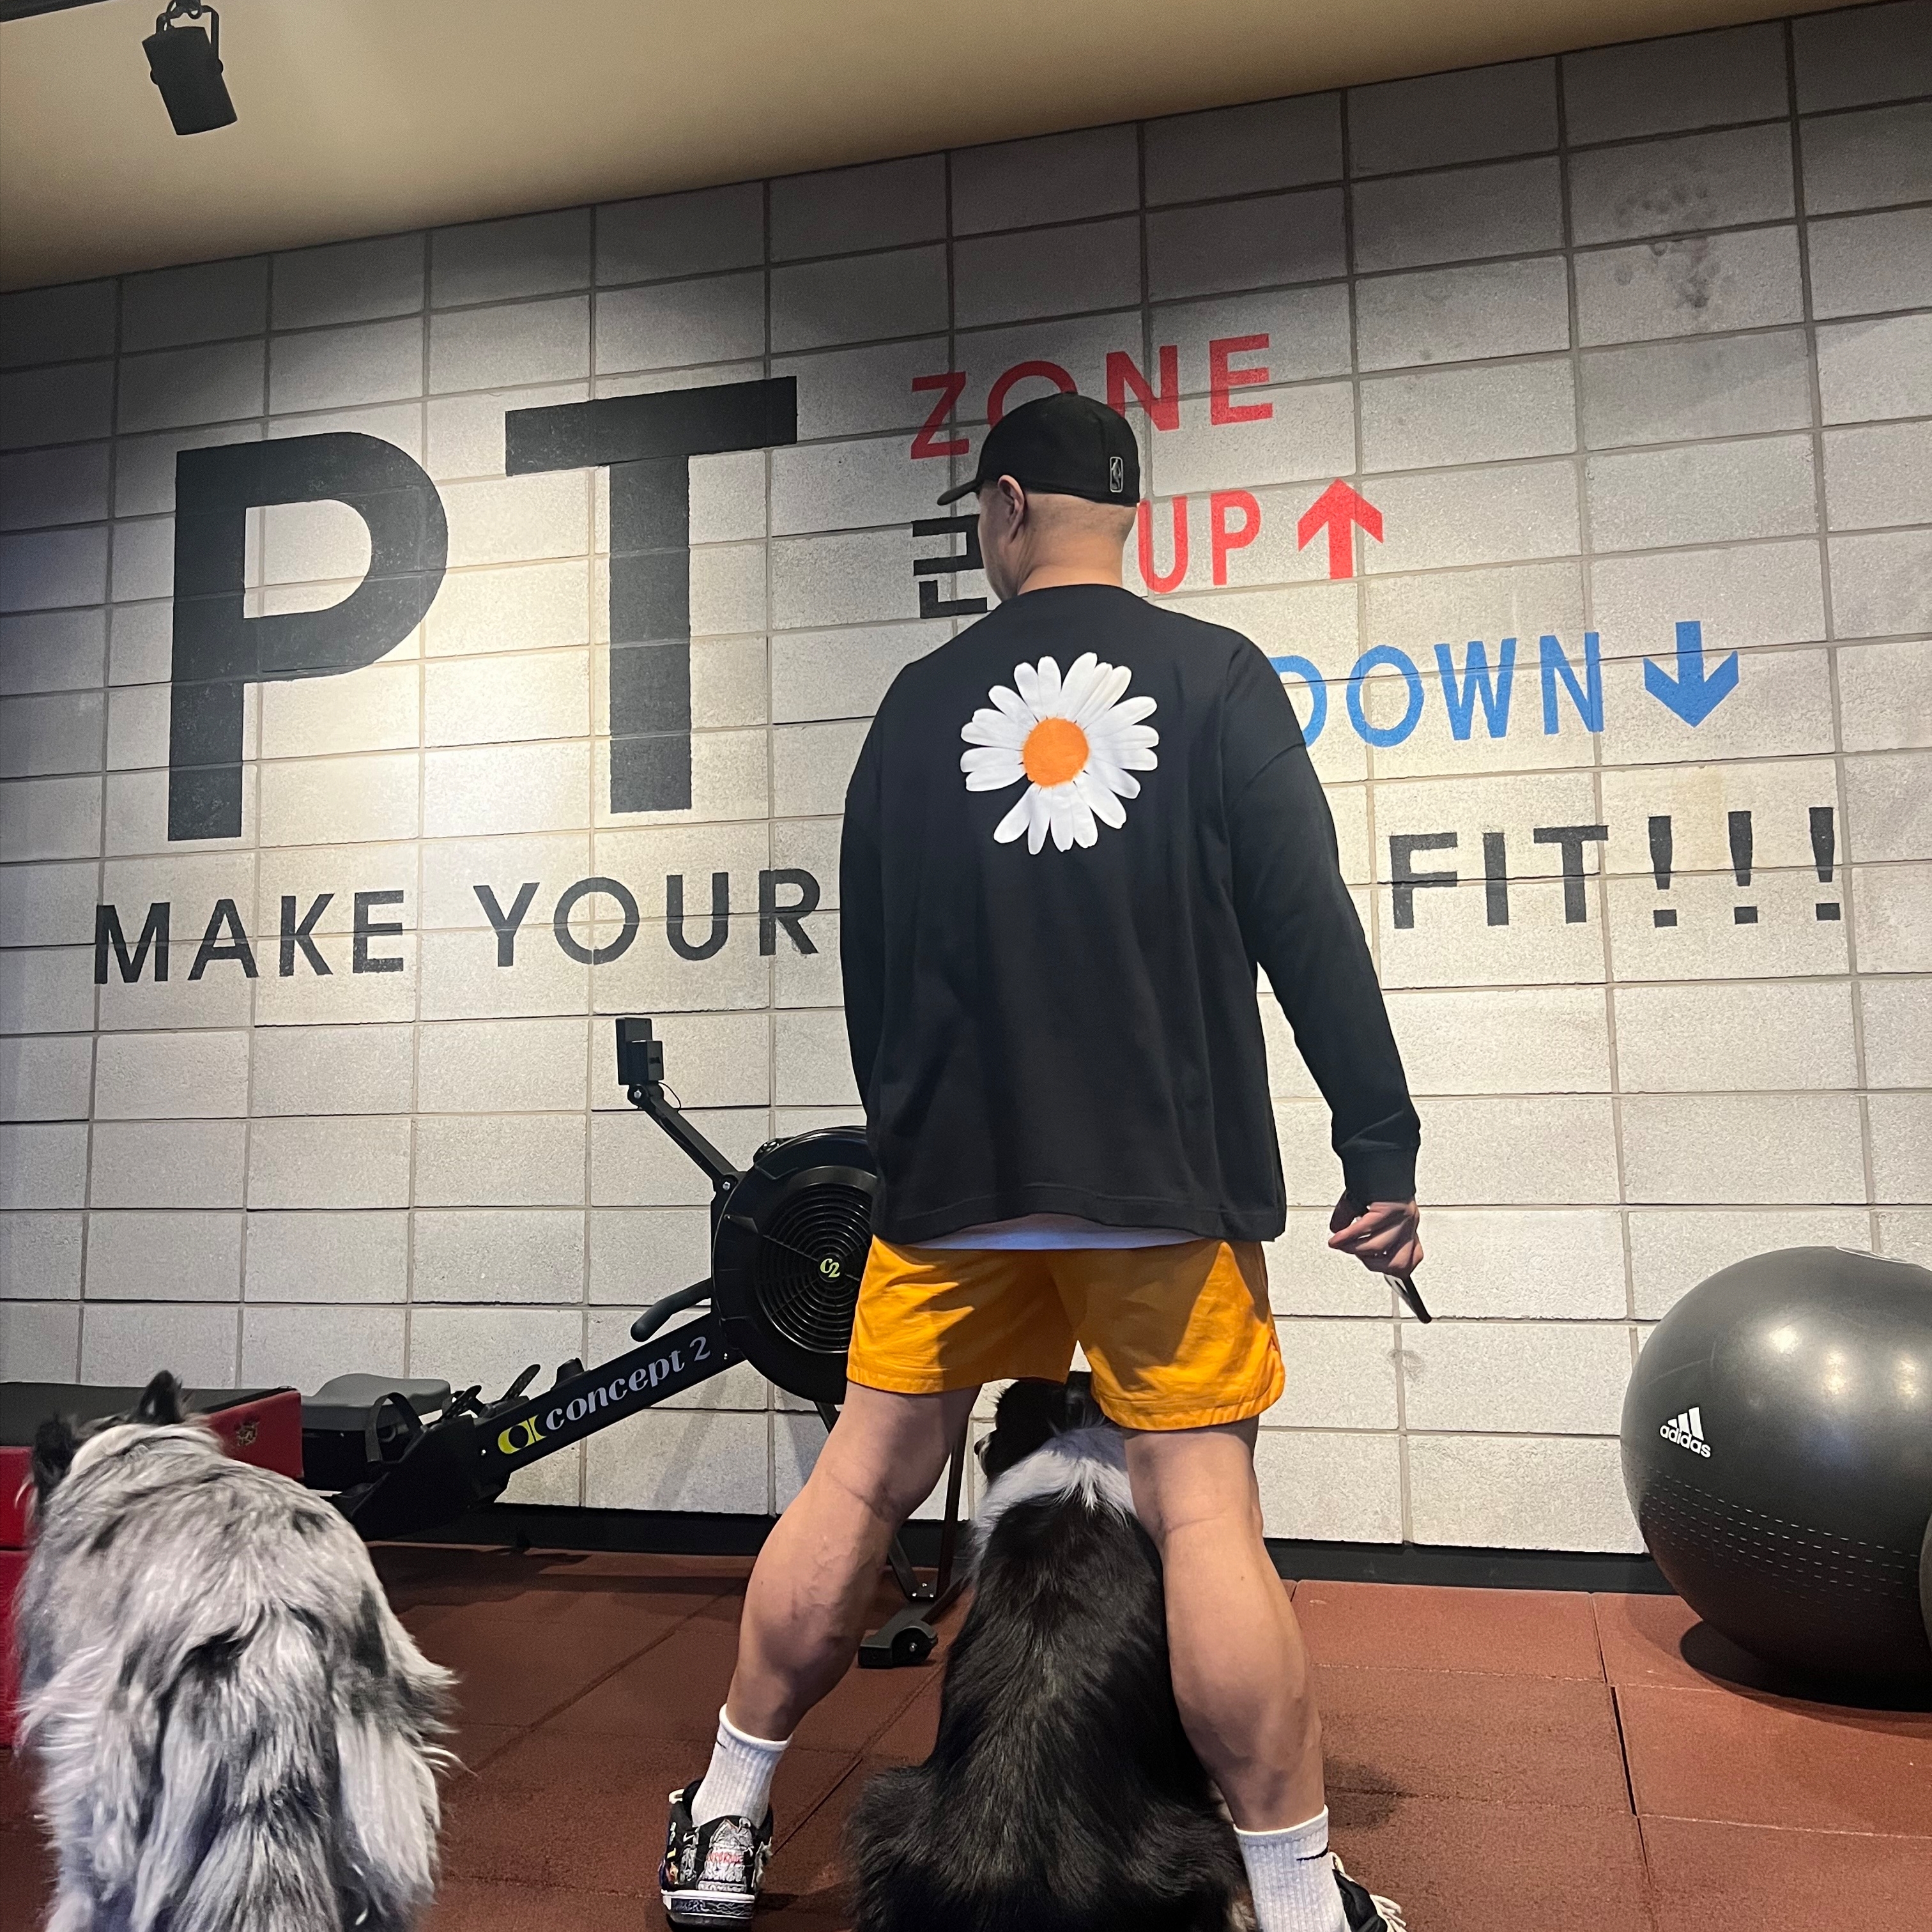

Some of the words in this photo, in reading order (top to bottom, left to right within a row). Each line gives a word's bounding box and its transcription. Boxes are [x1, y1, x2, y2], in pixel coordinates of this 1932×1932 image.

[910, 333, 1273, 460] ZONE
[1138, 489, 1261, 593] UP
[168, 376, 797, 841] PT
[1268, 631, 1604, 748] DOWN
[95, 889, 404, 985] MAKE
[473, 868, 821, 967] YOUR
[546, 1350, 686, 1431] concept
[689, 1336, 711, 1361] 2
[1659, 1425, 1711, 1458] adidas
